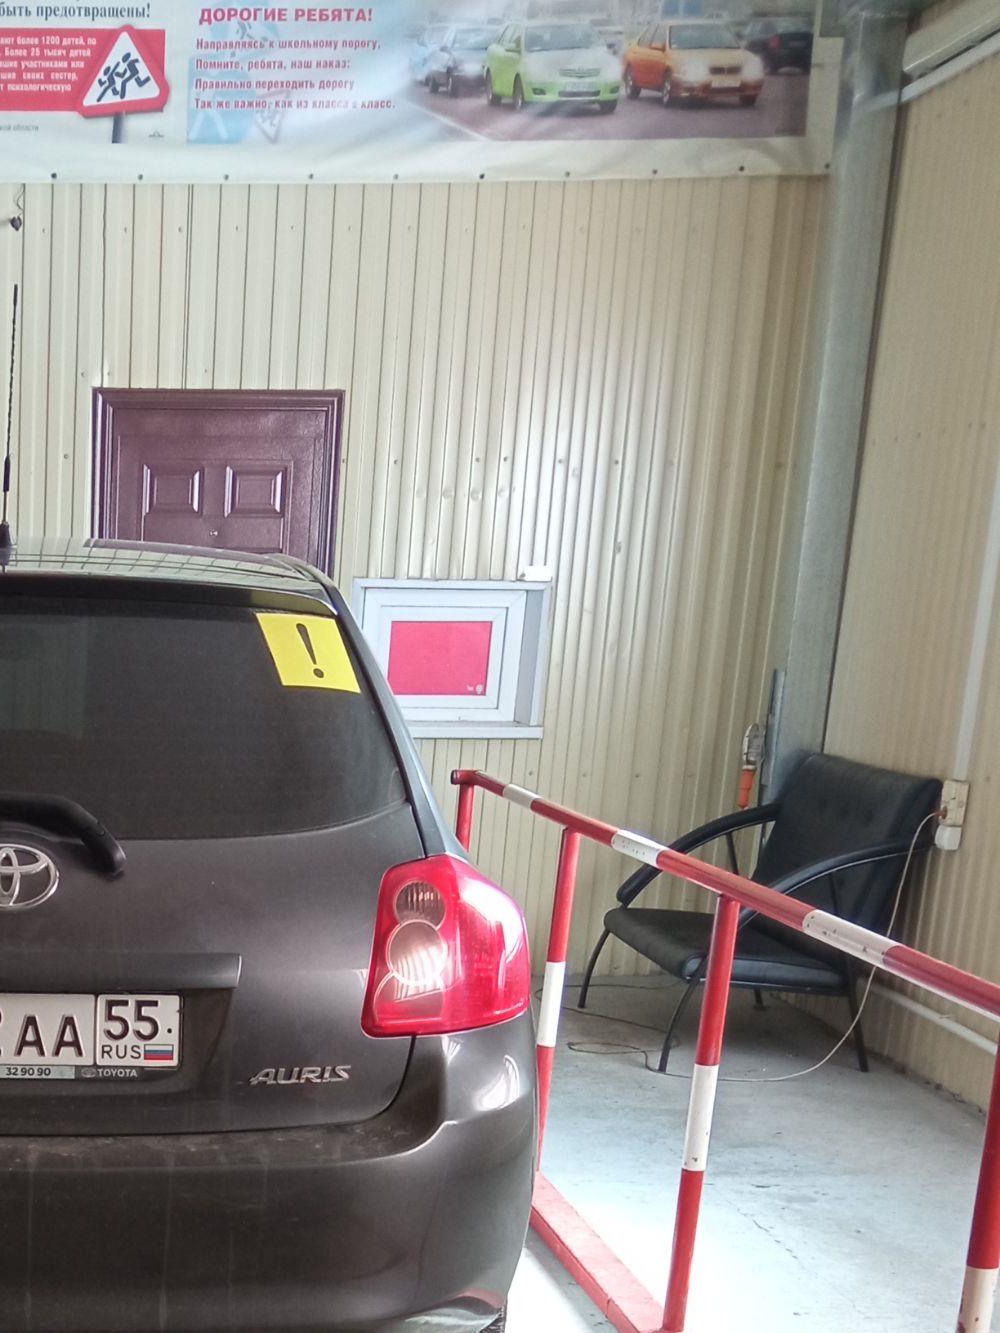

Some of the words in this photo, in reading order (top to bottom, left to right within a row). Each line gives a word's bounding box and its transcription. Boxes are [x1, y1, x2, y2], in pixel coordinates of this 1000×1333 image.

[36, 3, 151, 20] предотвращены!
[200, 8, 287, 25] ДОРОГИЕ
[294, 8, 372, 22] РЕБЯТА!
[42, 36, 60, 45] 1200
[196, 38, 264, 50] Направляясь
[269, 40, 274, 49] к
[278, 39, 338, 51] школьному
[342, 40, 381, 51] порогу,
[196, 59, 243, 72] Помните,
[248, 58, 287, 72] ребята,
[290, 60, 312, 70] наш
[196, 78, 252, 90] Правильно
[256, 78, 314, 91] переходить
[318, 79, 354, 91] дорогу
[195, 98, 213, 109] Так
[216, 99, 231, 109] же
[274, 99, 293, 109] как
[104, 1000, 160, 1042] 55
[102, 1044, 142, 1060] RUS
[6, 1067, 20, 1076] 32
[20, 1067, 35, 1076] 90
[37, 1067, 51, 1076] 90
[98, 1068, 138, 1078] TOYOTA
[249, 1065, 352, 1084] AURIS
